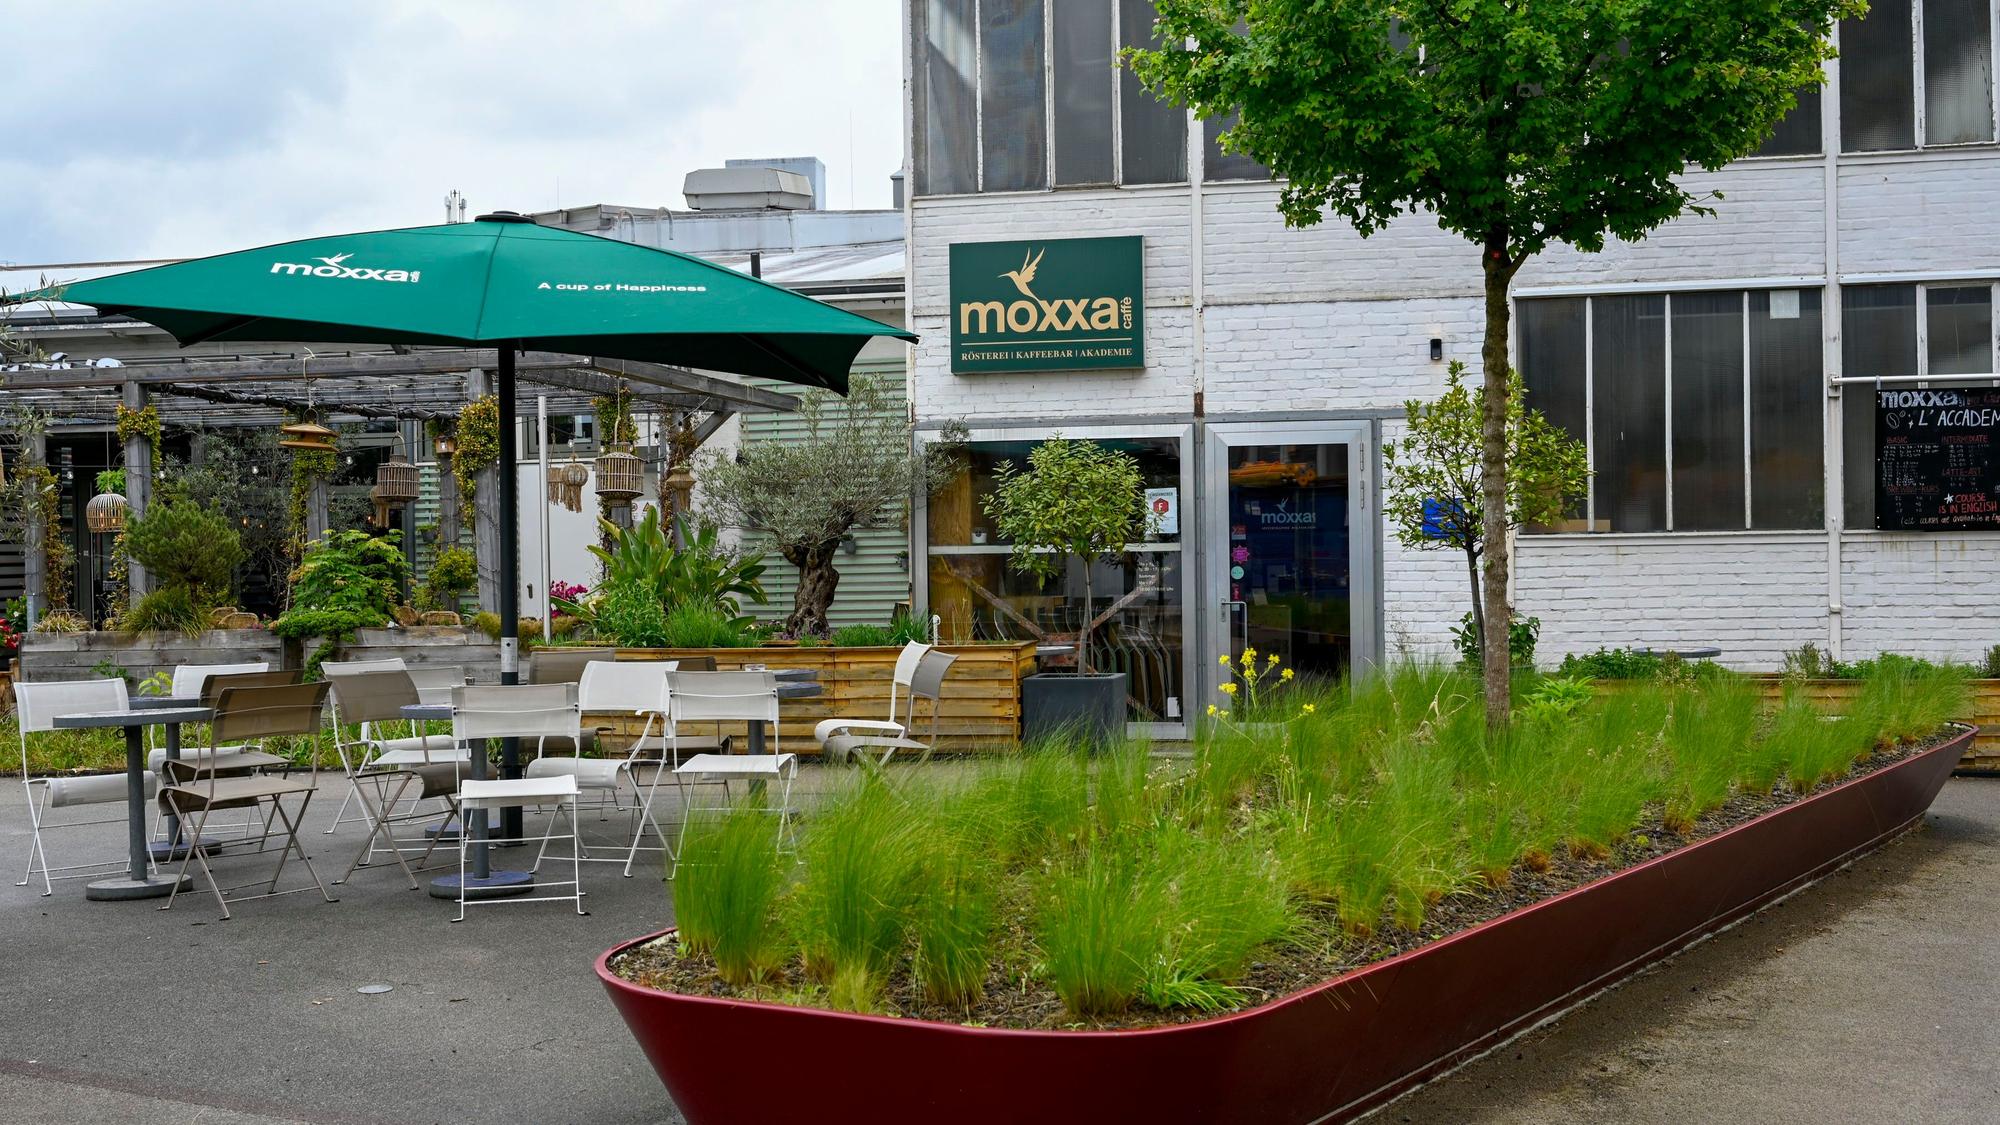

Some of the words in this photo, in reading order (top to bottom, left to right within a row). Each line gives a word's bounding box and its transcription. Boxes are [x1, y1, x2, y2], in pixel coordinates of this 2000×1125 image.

[270, 262, 409, 282] moxxa
[537, 282, 551, 290] A
[556, 283, 589, 292] cup
[594, 283, 611, 291] of
[616, 284, 707, 292] Happiness
[960, 297, 1120, 334] moxxa
[961, 350, 1009, 361] RÖSTEREI
[1016, 349, 1073, 360] KAFFEEBAR
[1080, 347, 1133, 357] AKADEMIE
[1881, 391, 1958, 408] moxxa
[1955, 493, 1987, 503] COURSE
[1938, 505, 1947, 514] IS
[1949, 504, 1958, 513] IN
[1961, 501, 1998, 513] ENGLISH
[1261, 512, 1312, 524] moxxa
